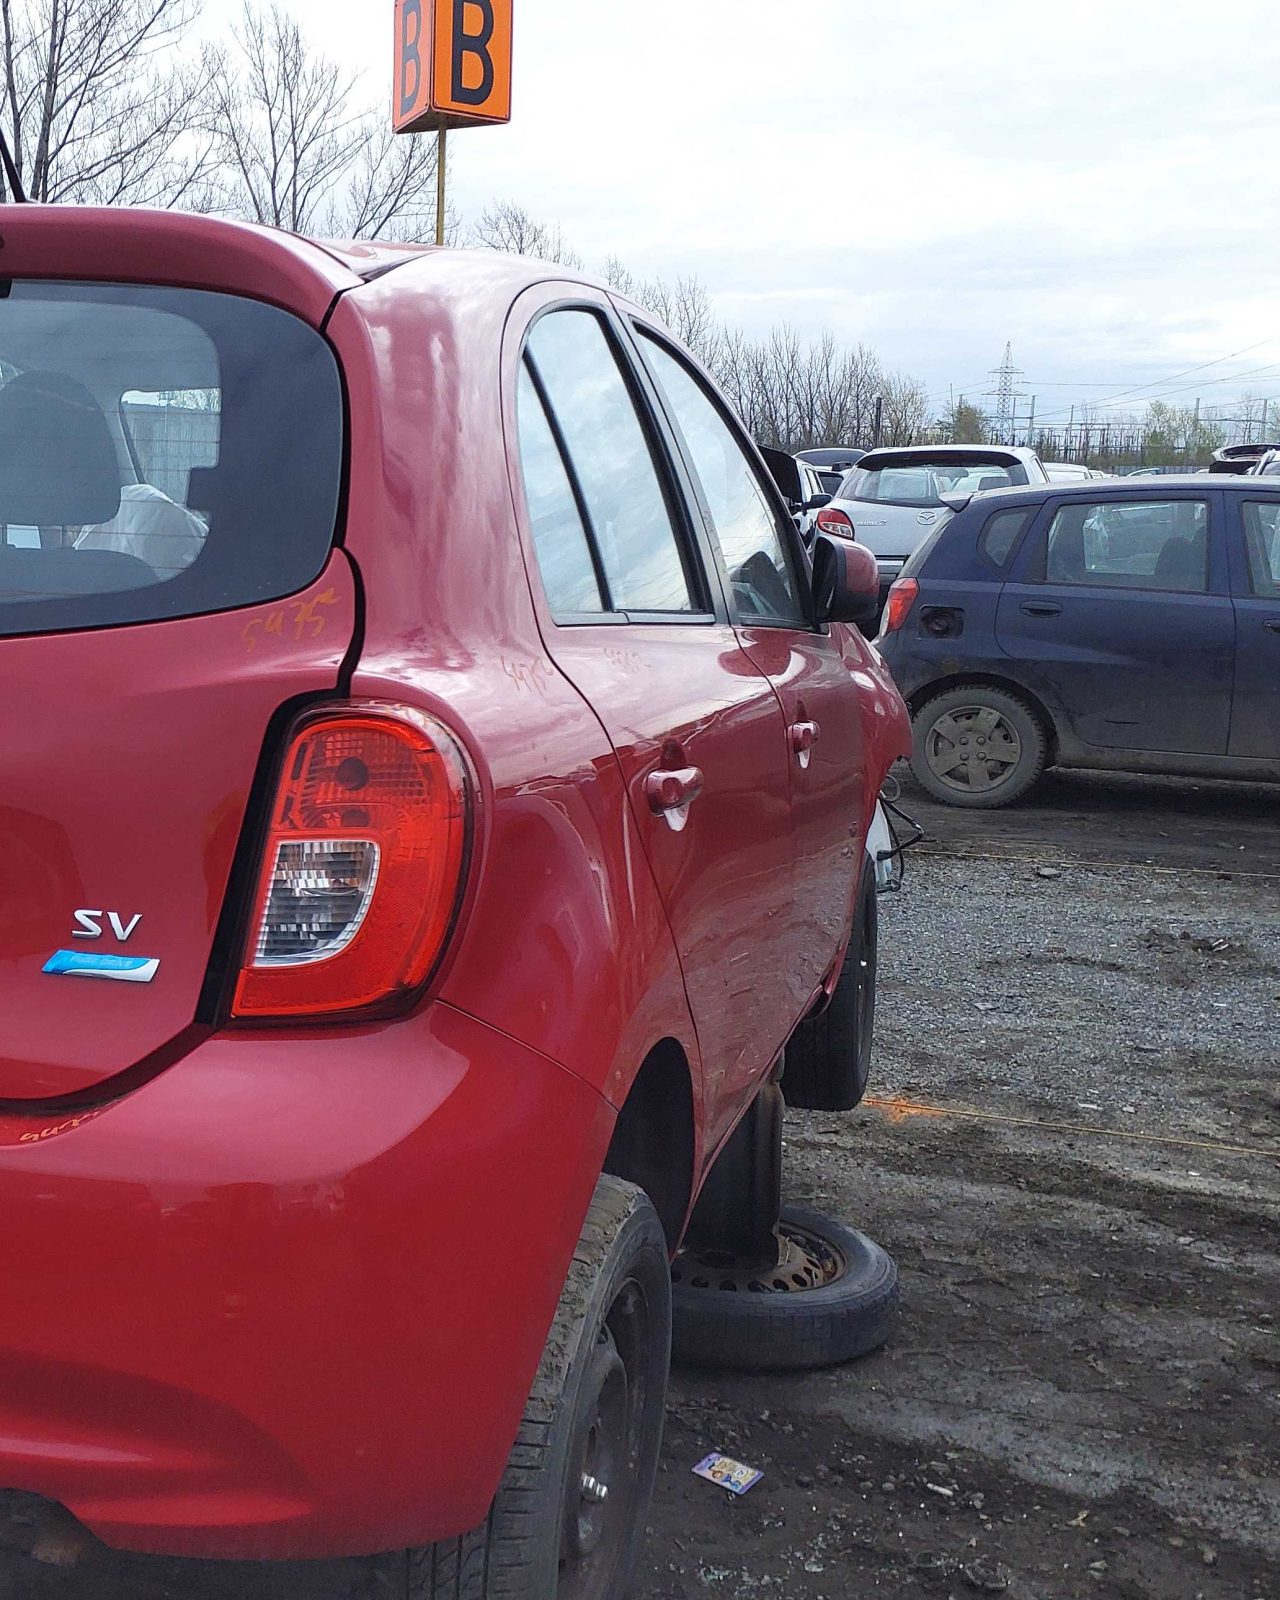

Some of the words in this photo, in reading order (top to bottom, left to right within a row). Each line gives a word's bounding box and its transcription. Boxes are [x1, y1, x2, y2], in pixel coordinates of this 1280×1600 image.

[400, 0, 421, 117] B
[451, 0, 494, 105] B
[71, 909, 143, 941] SV
